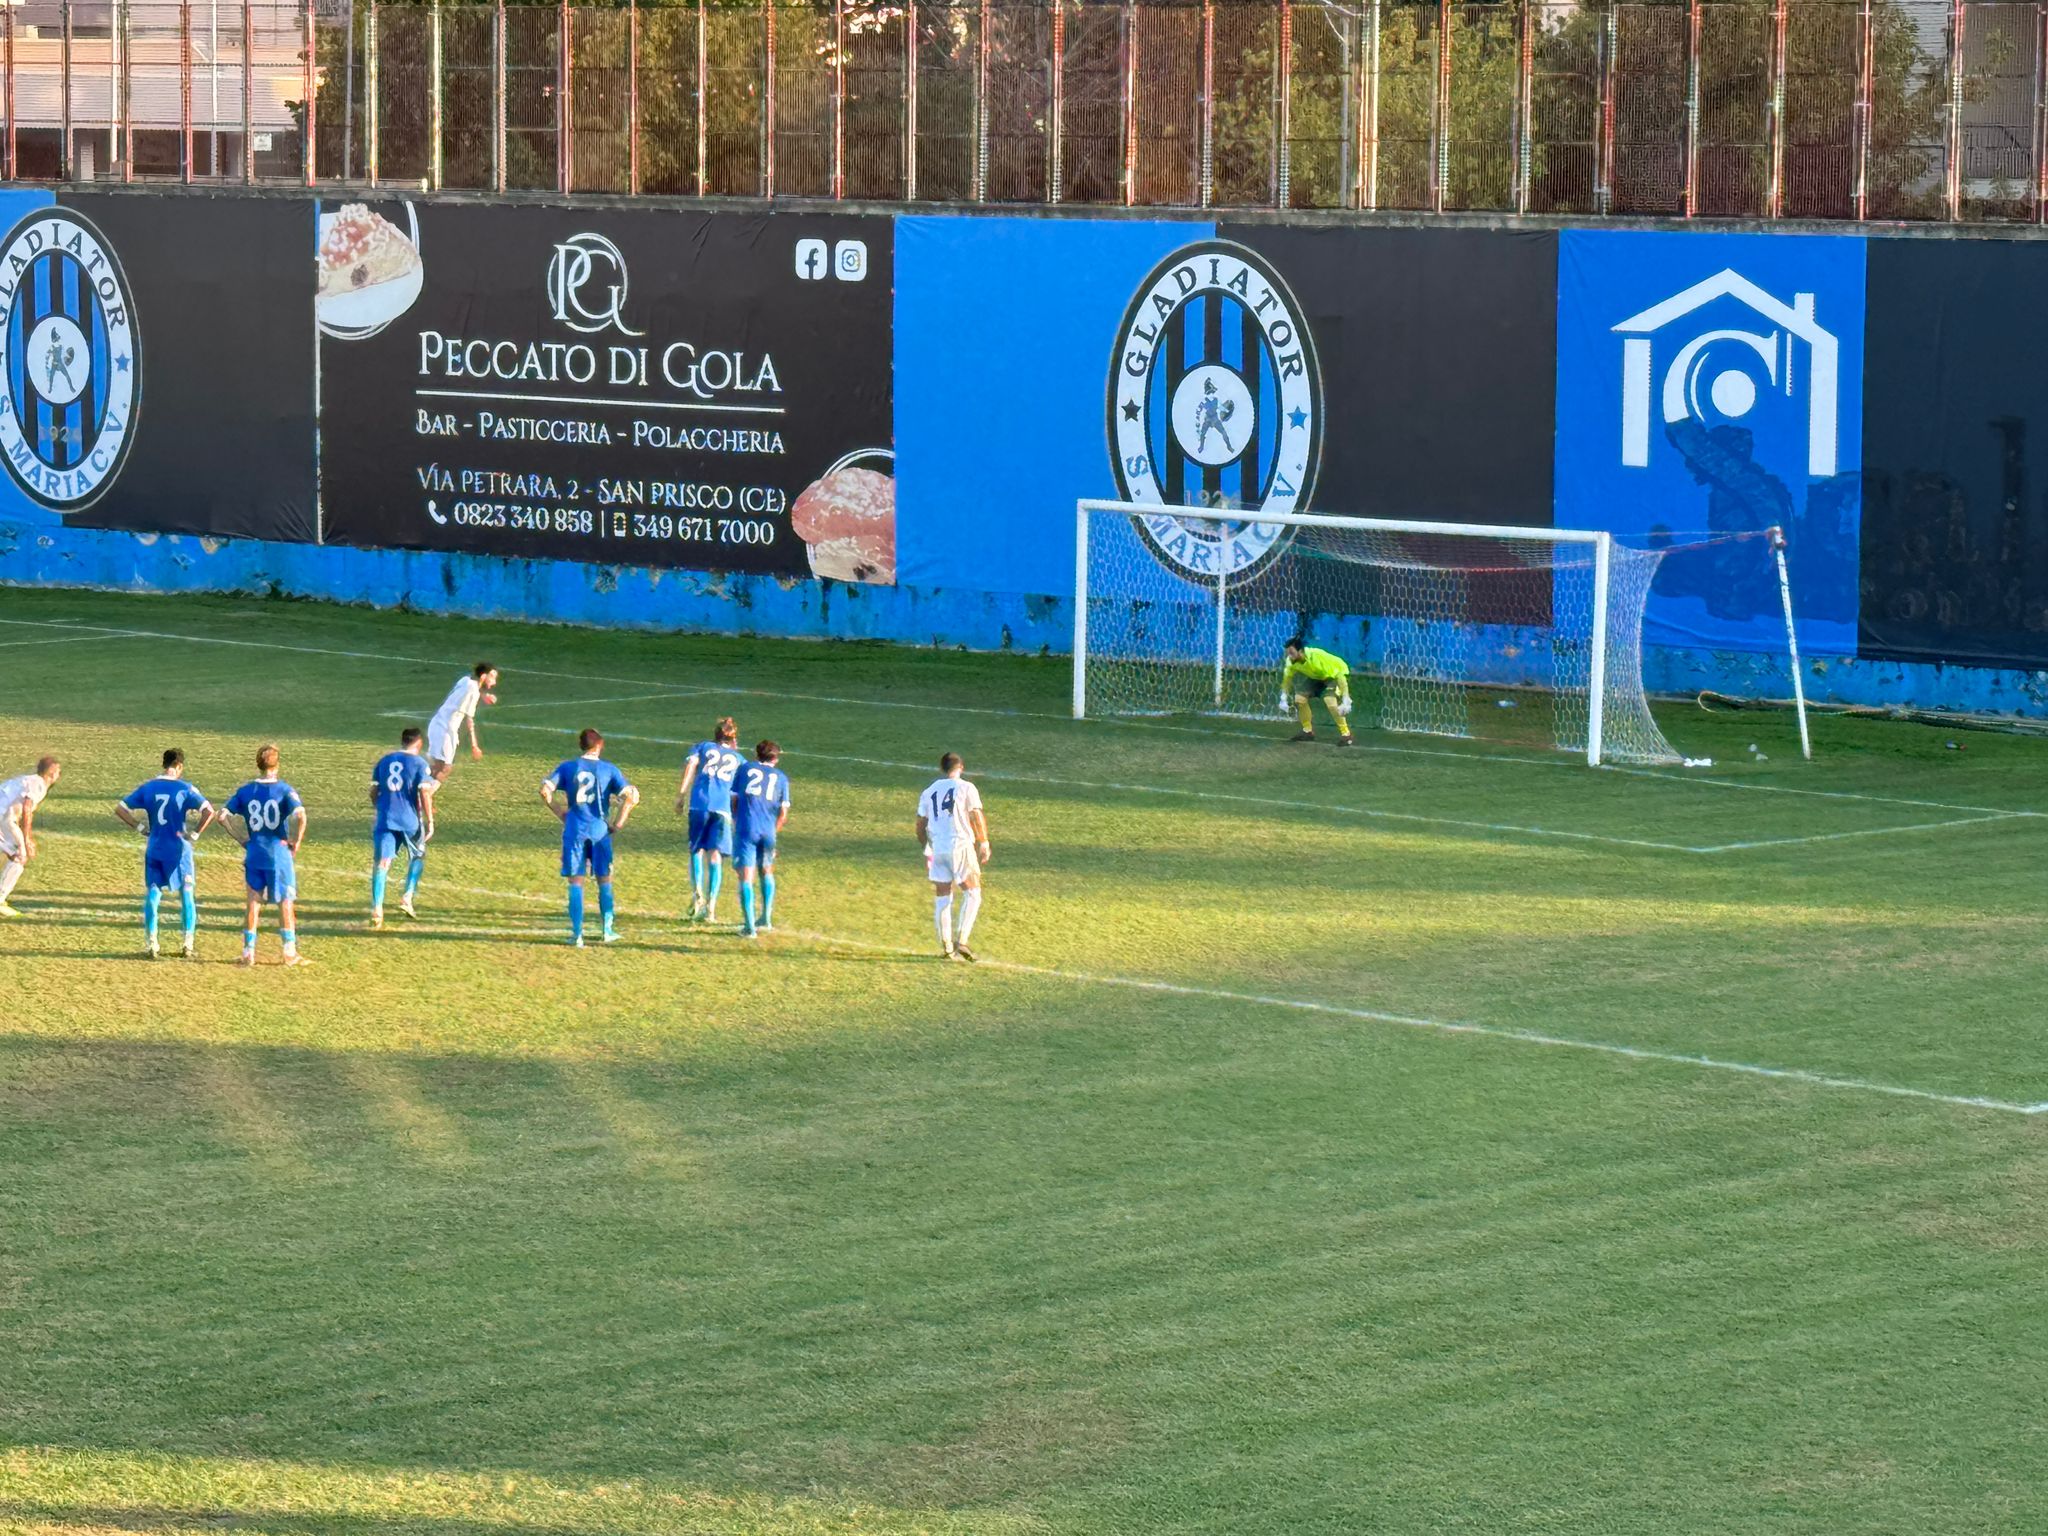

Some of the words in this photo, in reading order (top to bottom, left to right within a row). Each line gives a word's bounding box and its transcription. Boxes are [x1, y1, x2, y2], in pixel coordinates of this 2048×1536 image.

[1124, 258, 1304, 383] GLADIATOR
[418, 330, 597, 384] PECCATO
[608, 346, 649, 386] DI
[661, 341, 783, 399] GOLA
[415, 408, 460, 440] BAR
[478, 411, 613, 446] PASTICCERIA
[632, 420, 787, 455] POLACCHERIA
[9, 437, 94, 498] MARIA
[416, 462, 456, 493] VIA
[566, 479, 580, 501] 2
[597, 478, 645, 506] SAN
[650, 481, 734, 510] PRISCO
[738, 486, 787, 516] (CE)
[453, 501, 507, 528] 0823
[510, 505, 551, 531] 340
[553, 508, 594, 534] 858
[633, 512, 674, 539] 349
[677, 515, 714, 542] 671
[716, 518, 776, 547] 7000
[388, 760, 405, 793] 8
[705, 748, 739, 782] 22
[576, 770, 597, 804] 2
[747, 767, 778, 801] 21
[154, 793, 171, 826] 7
[247, 799, 282, 832] 80
[930, 787, 957, 819] 14
